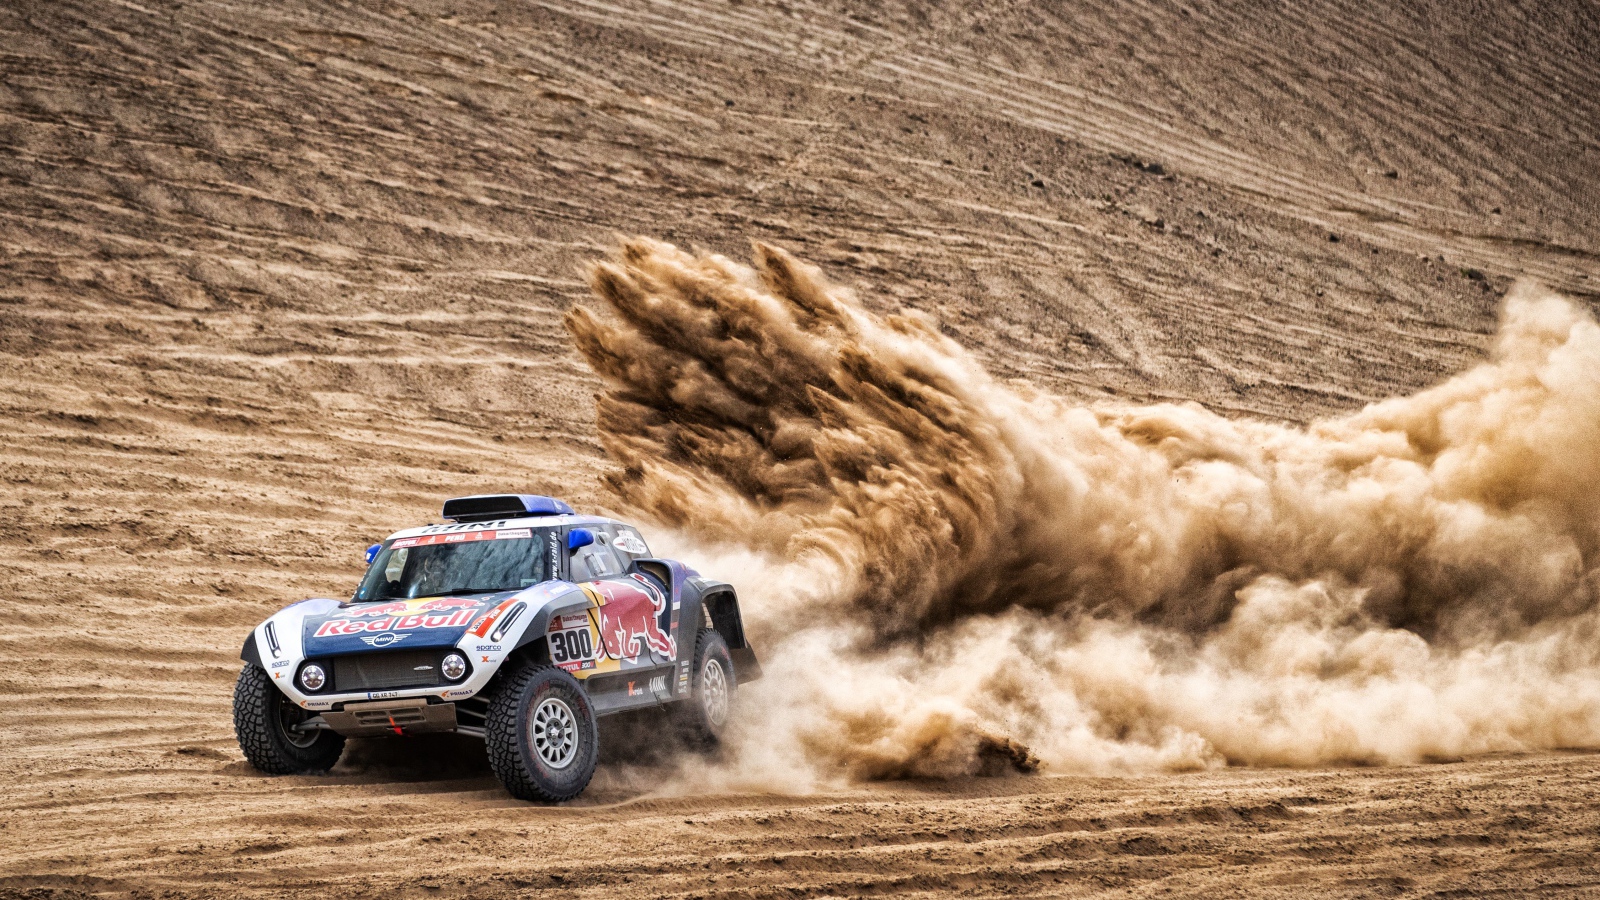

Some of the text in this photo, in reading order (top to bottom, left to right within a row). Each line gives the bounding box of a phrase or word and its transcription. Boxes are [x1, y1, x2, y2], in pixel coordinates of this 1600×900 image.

[313, 619, 395, 637] Red
[395, 609, 479, 631] Bull
[551, 628, 593, 662] 300
